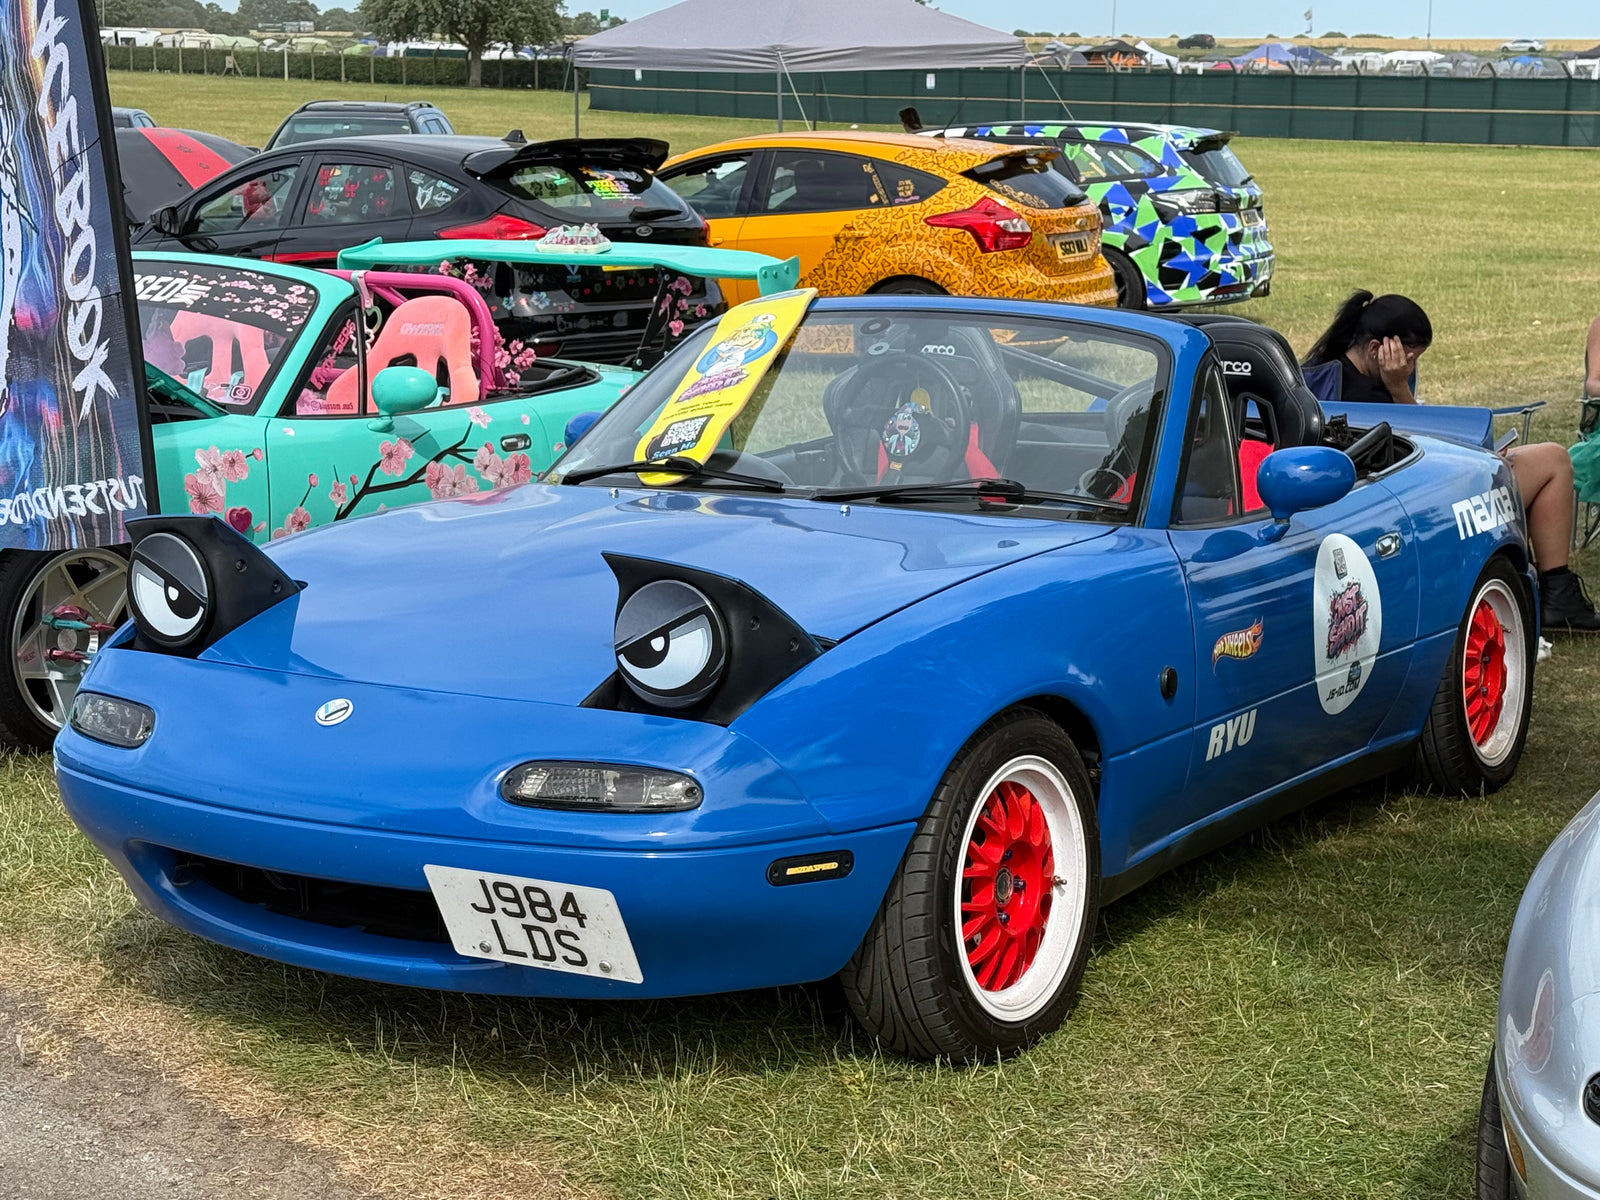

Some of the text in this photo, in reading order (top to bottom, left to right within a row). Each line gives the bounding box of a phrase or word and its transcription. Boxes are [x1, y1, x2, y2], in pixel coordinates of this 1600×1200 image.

[134, 274, 188, 302] SED
[1205, 708, 1258, 762] RYU
[470, 878, 588, 929] J984
[490, 918, 589, 968] LDS
